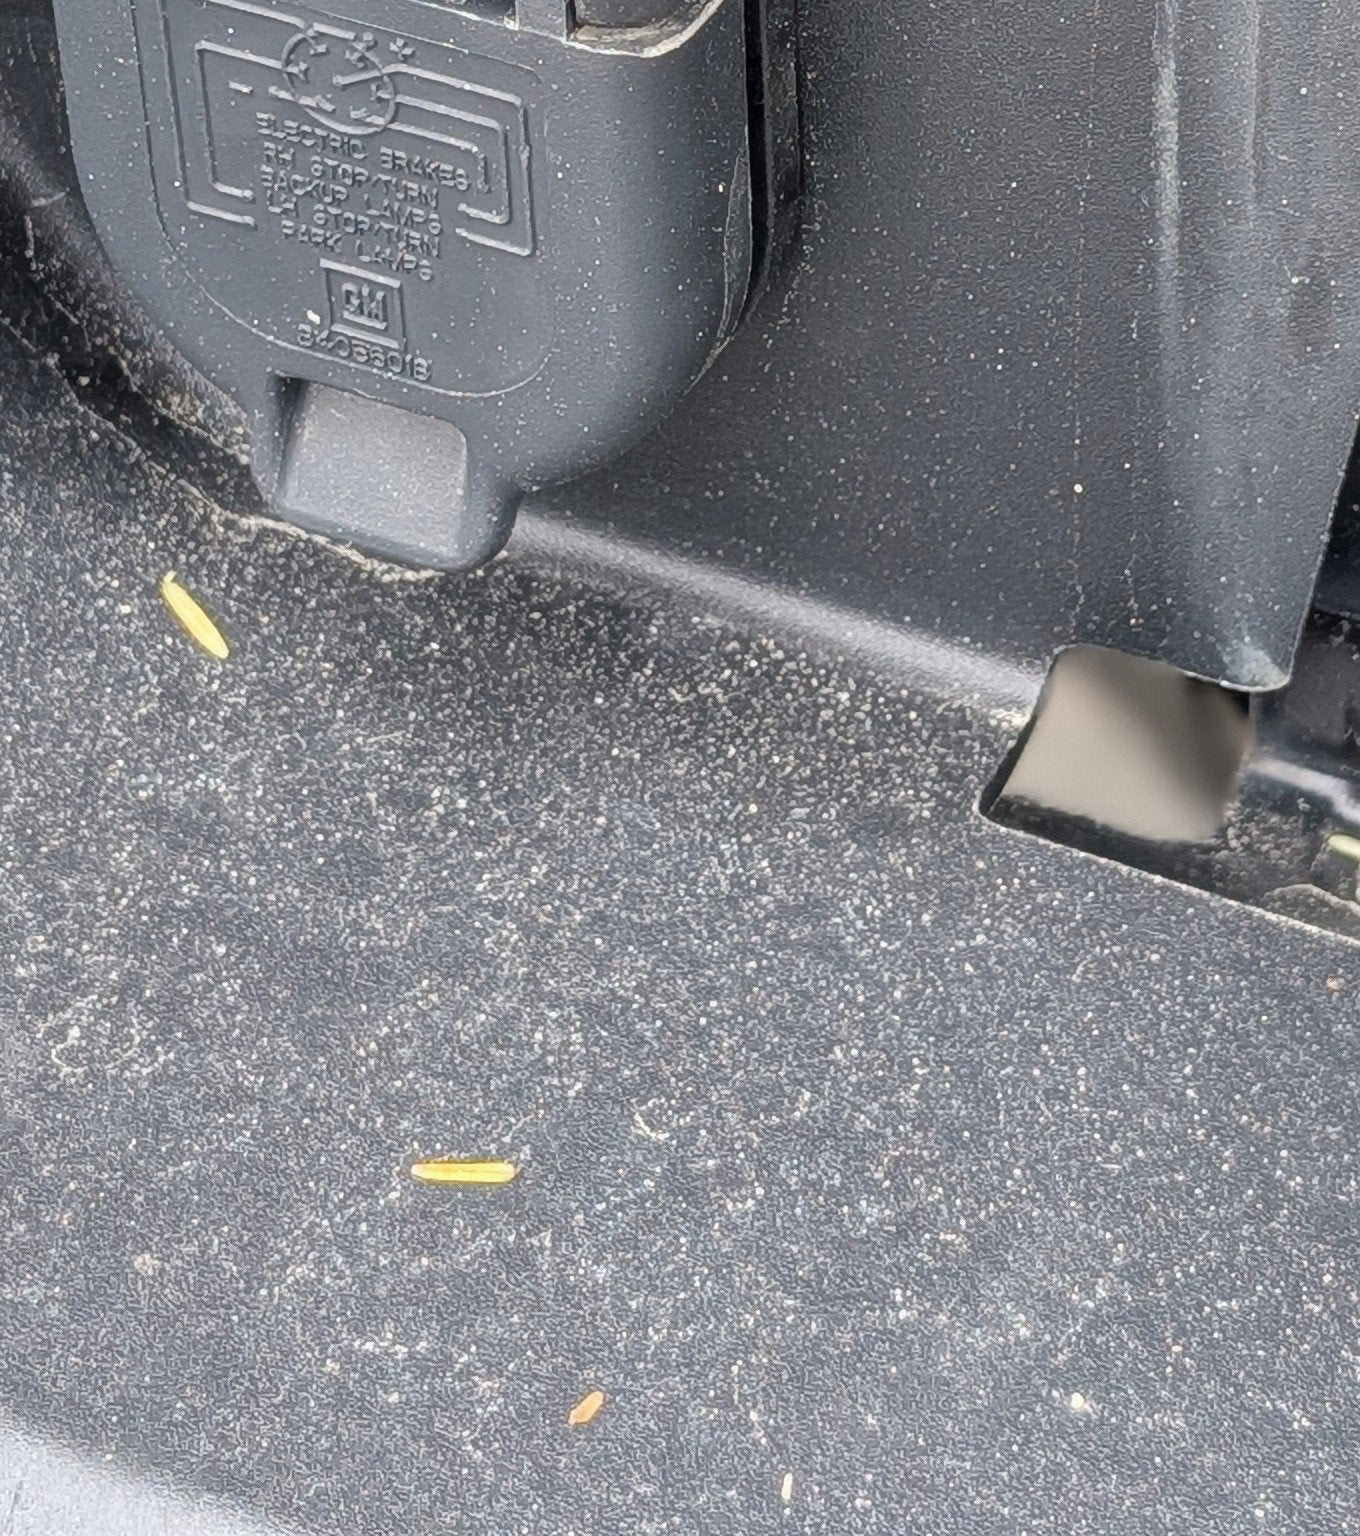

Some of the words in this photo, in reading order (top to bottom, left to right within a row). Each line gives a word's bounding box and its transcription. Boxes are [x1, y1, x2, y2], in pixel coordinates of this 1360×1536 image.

[256, 111, 368, 160] ELECTRIC
[380, 146, 469, 192] BRAKES
[260, 164, 347, 203] BACKUP
[364, 193, 442, 235] LAMPS
